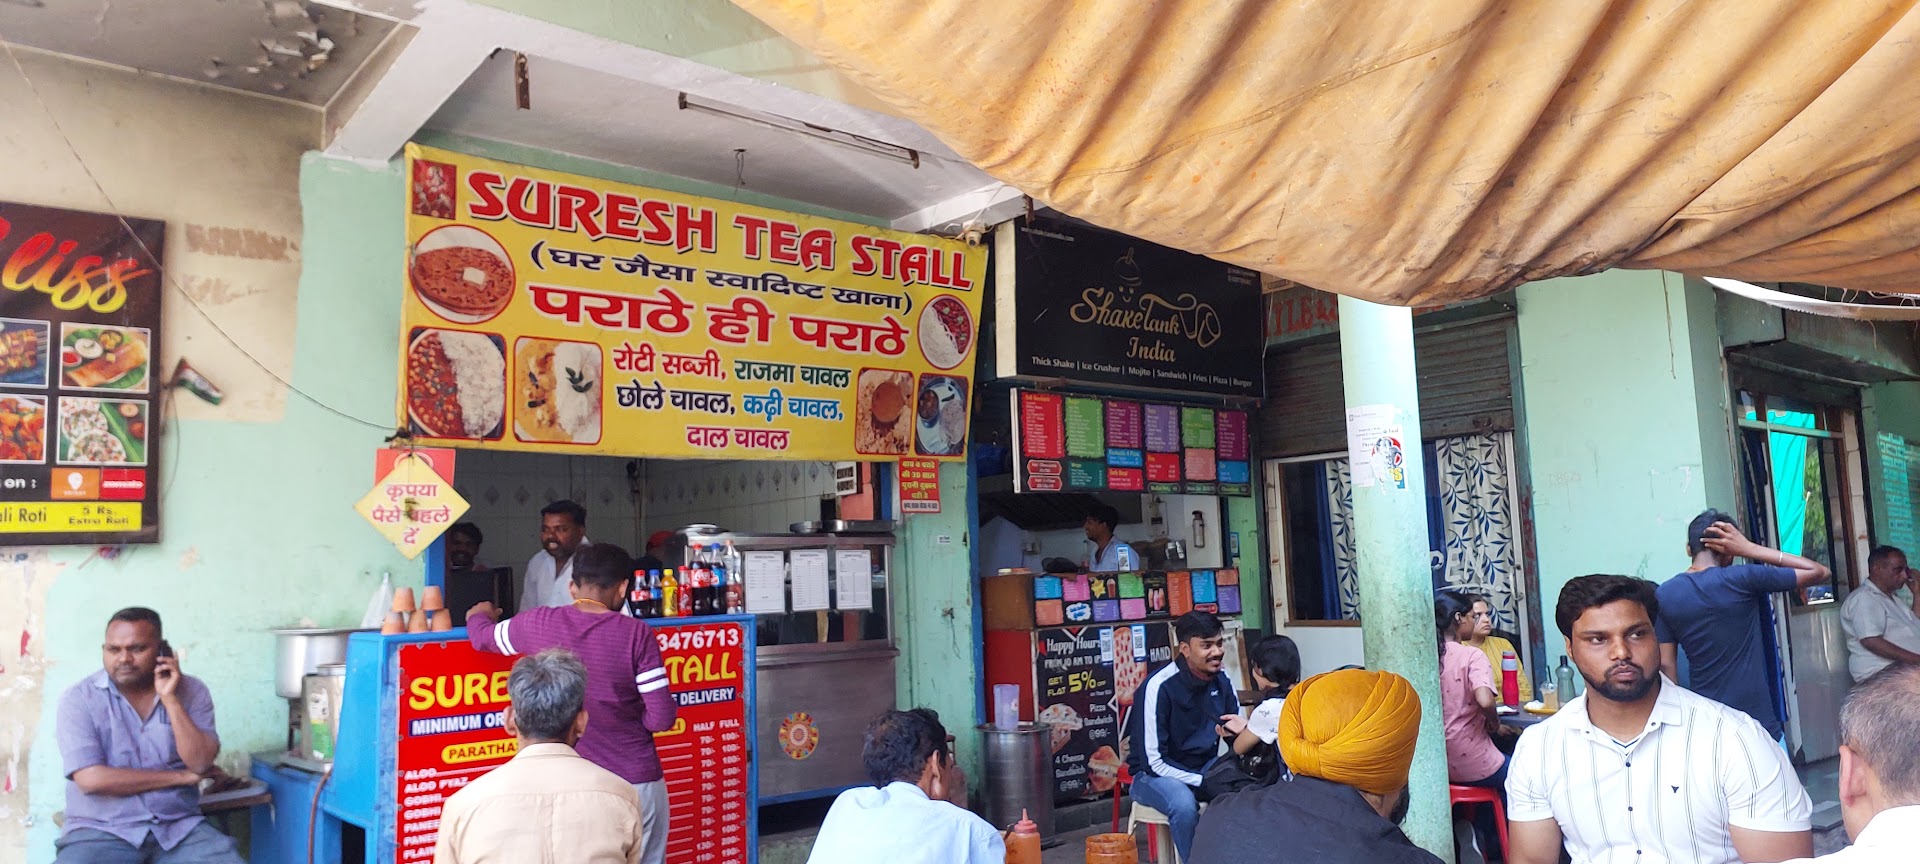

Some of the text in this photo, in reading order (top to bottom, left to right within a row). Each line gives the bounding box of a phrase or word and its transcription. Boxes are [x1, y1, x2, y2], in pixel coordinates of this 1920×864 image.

[468, 172, 972, 290] SURESH TEA STALL
[0, 216, 152, 313] liss
[611, 254, 697, 282] जैसा
[706, 273, 825, 299] स्वादिष्ट
[529, 285, 909, 355] पराठे ही पराठे
[1126, 336, 1177, 363] India
[613, 342, 851, 388] रोटी सब्जी, राजमा चावल
[1032, 356, 1252, 388] Thick Shake Ice Crusher Mojito Sandwich Fries Pizza Burger
[616, 379, 843, 422] छोले चावल, कढ़ी चावल,
[687, 427, 790, 450] दाल चावल
[4, 478, 26, 489] on
[386, 484, 438, 502] कृपया
[18, 507, 47, 523] Roti
[83, 506, 90, 514] 5
[372, 505, 452, 524] पैसे पहले
[403, 527, 419, 544] दें
[1430, 544, 1485, 582] PEN
[656, 628, 739, 651] 3476713
[1046, 637, 1074, 655] Happy
[664, 652, 737, 684] TALL
[1073, 656, 1083, 666] AM
[1048, 676, 1063, 686] GET
[409, 671, 512, 711] SURE
[680, 687, 734, 705] DELIVERY
[1047, 686, 1066, 696] FLAT
[412, 714, 482, 736] MINIMUM
[693, 718, 740, 732] HALF FULL
[404, 768, 437, 781] ALOO
[404, 781, 437, 794] ALOO
[404, 793, 442, 807] GOBHI
[404, 806, 441, 820] GOBHI
[403, 819, 440, 833] PANEE
[403, 832, 439, 847] PANEE
